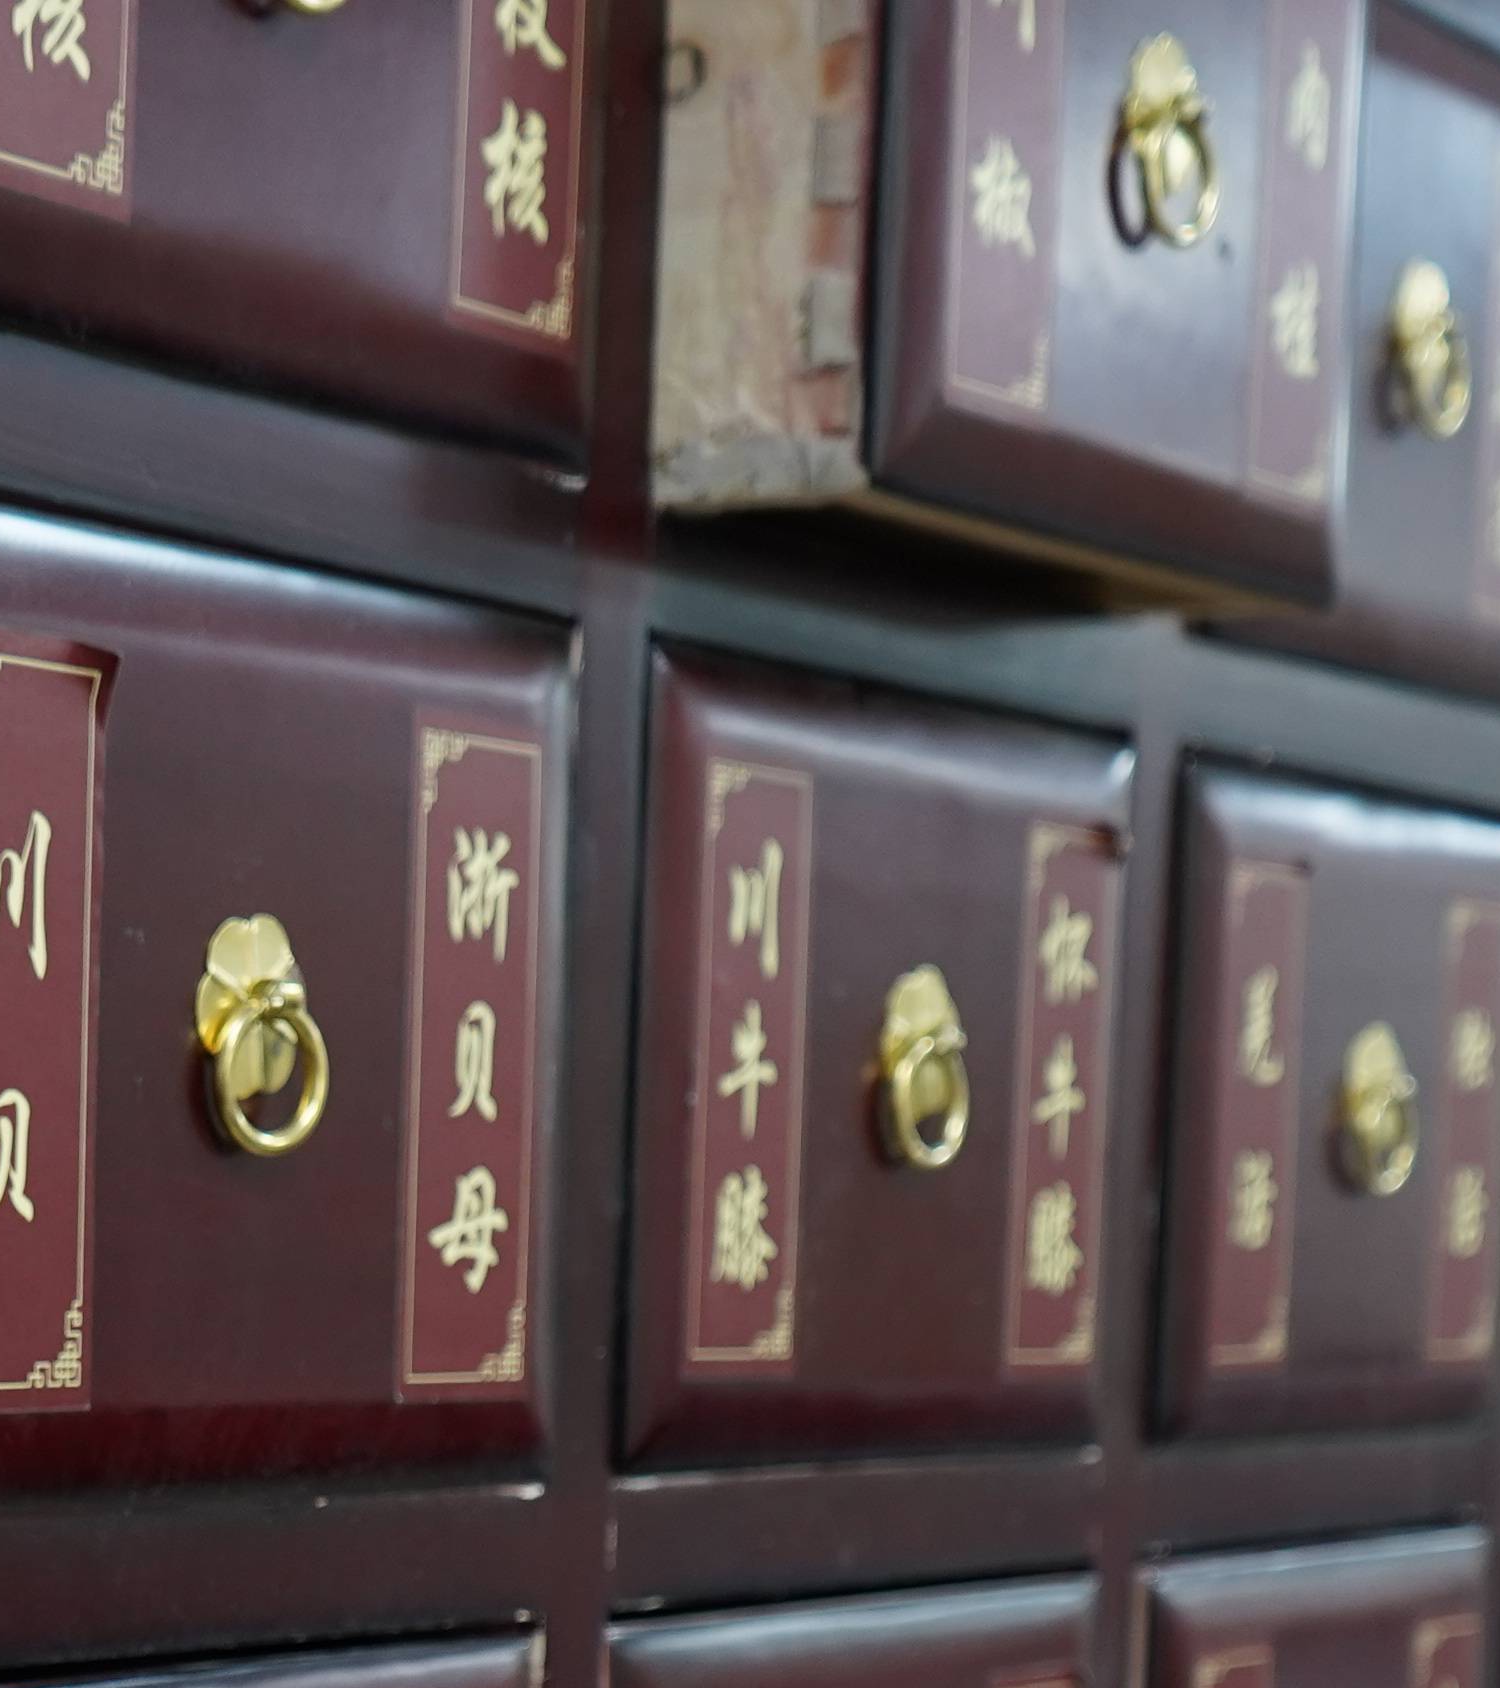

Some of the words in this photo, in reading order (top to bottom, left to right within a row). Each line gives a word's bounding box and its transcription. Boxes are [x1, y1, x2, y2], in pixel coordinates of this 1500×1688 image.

[428, 825, 520, 1295] 浙贝母
[711, 836, 780, 1292] 川牛膝
